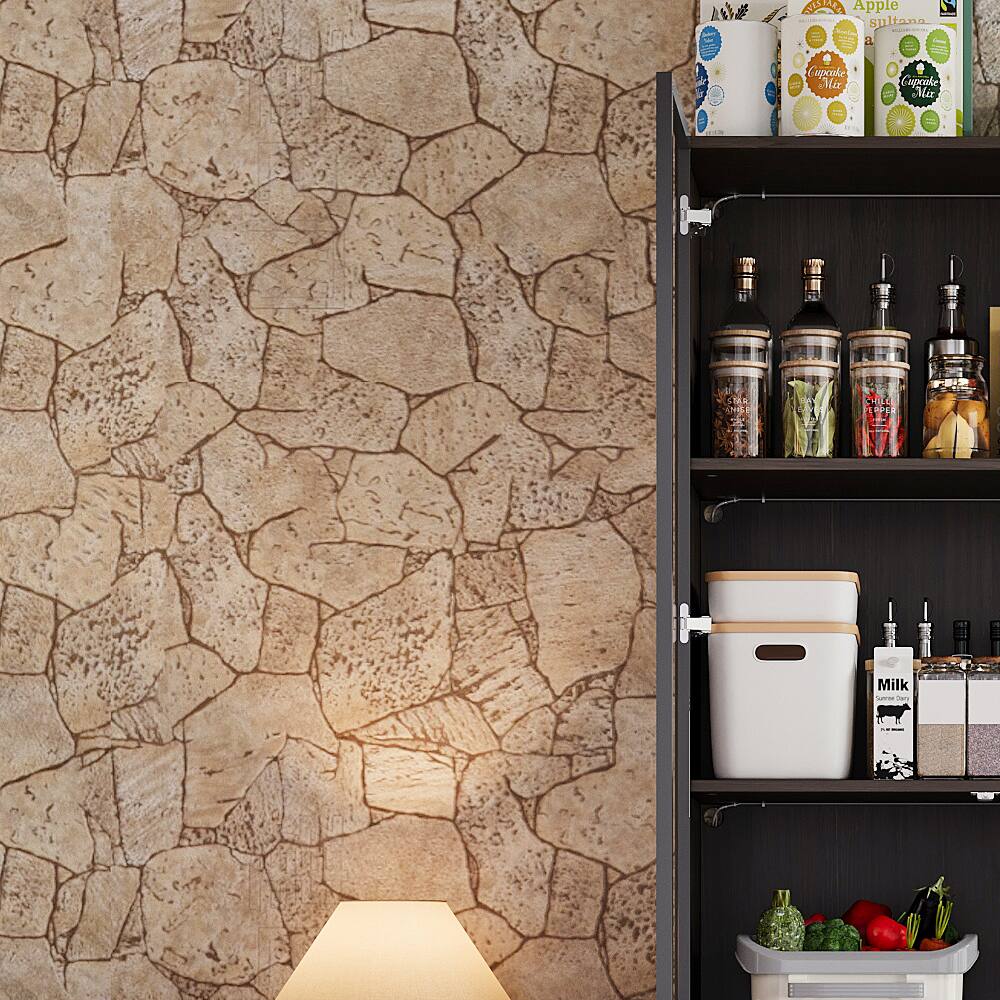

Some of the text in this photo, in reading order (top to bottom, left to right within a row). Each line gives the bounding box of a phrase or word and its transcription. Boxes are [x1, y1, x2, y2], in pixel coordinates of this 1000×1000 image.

[853, 0, 899, 13] Apple
[807, 65, 846, 80] Cupcake
[818, 77, 842, 89] Mix
[901, 74, 939, 89] Cupcake
[911, 86, 936, 98] Mix
[878, 678, 909, 691] Milk
